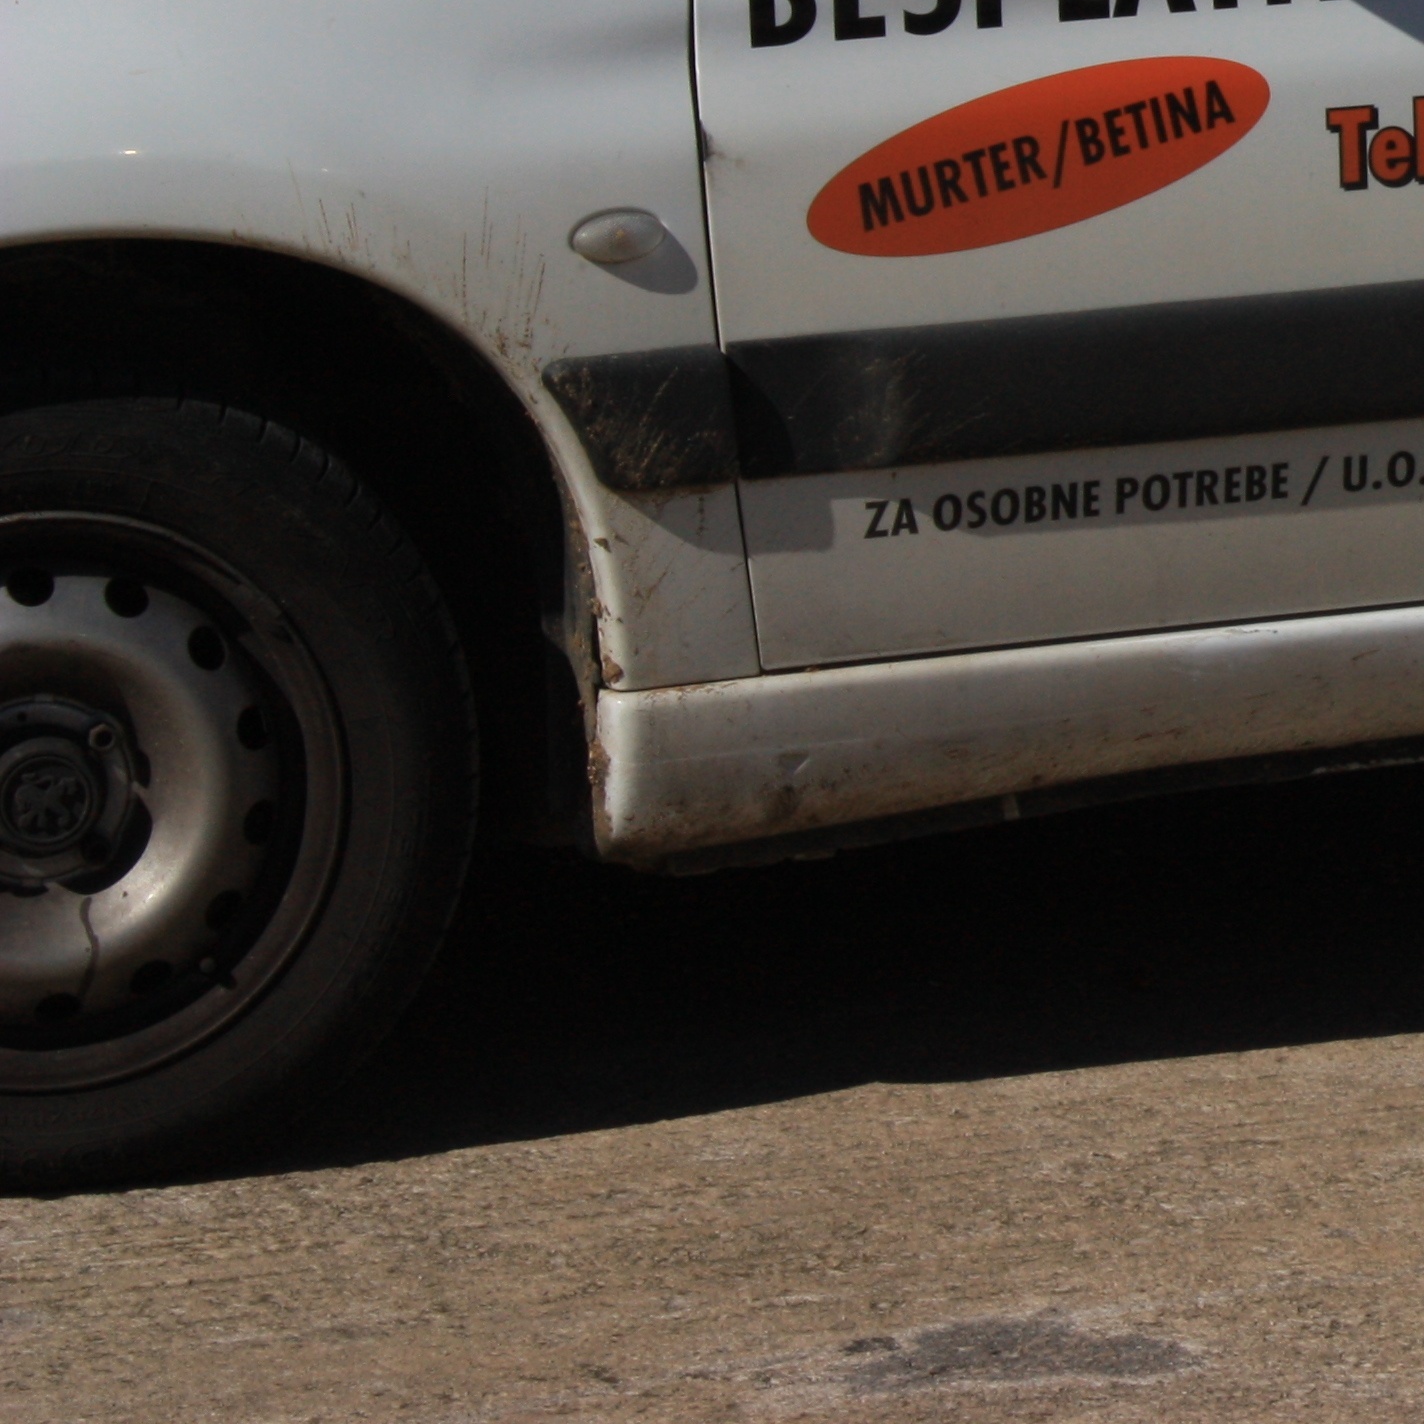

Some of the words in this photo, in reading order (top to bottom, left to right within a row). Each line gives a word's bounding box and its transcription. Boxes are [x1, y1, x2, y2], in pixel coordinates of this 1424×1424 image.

[863, 499, 920, 540] ZA
[931, 479, 1101, 533] OSOBNE
[1114, 461, 1290, 516] POTREBE
